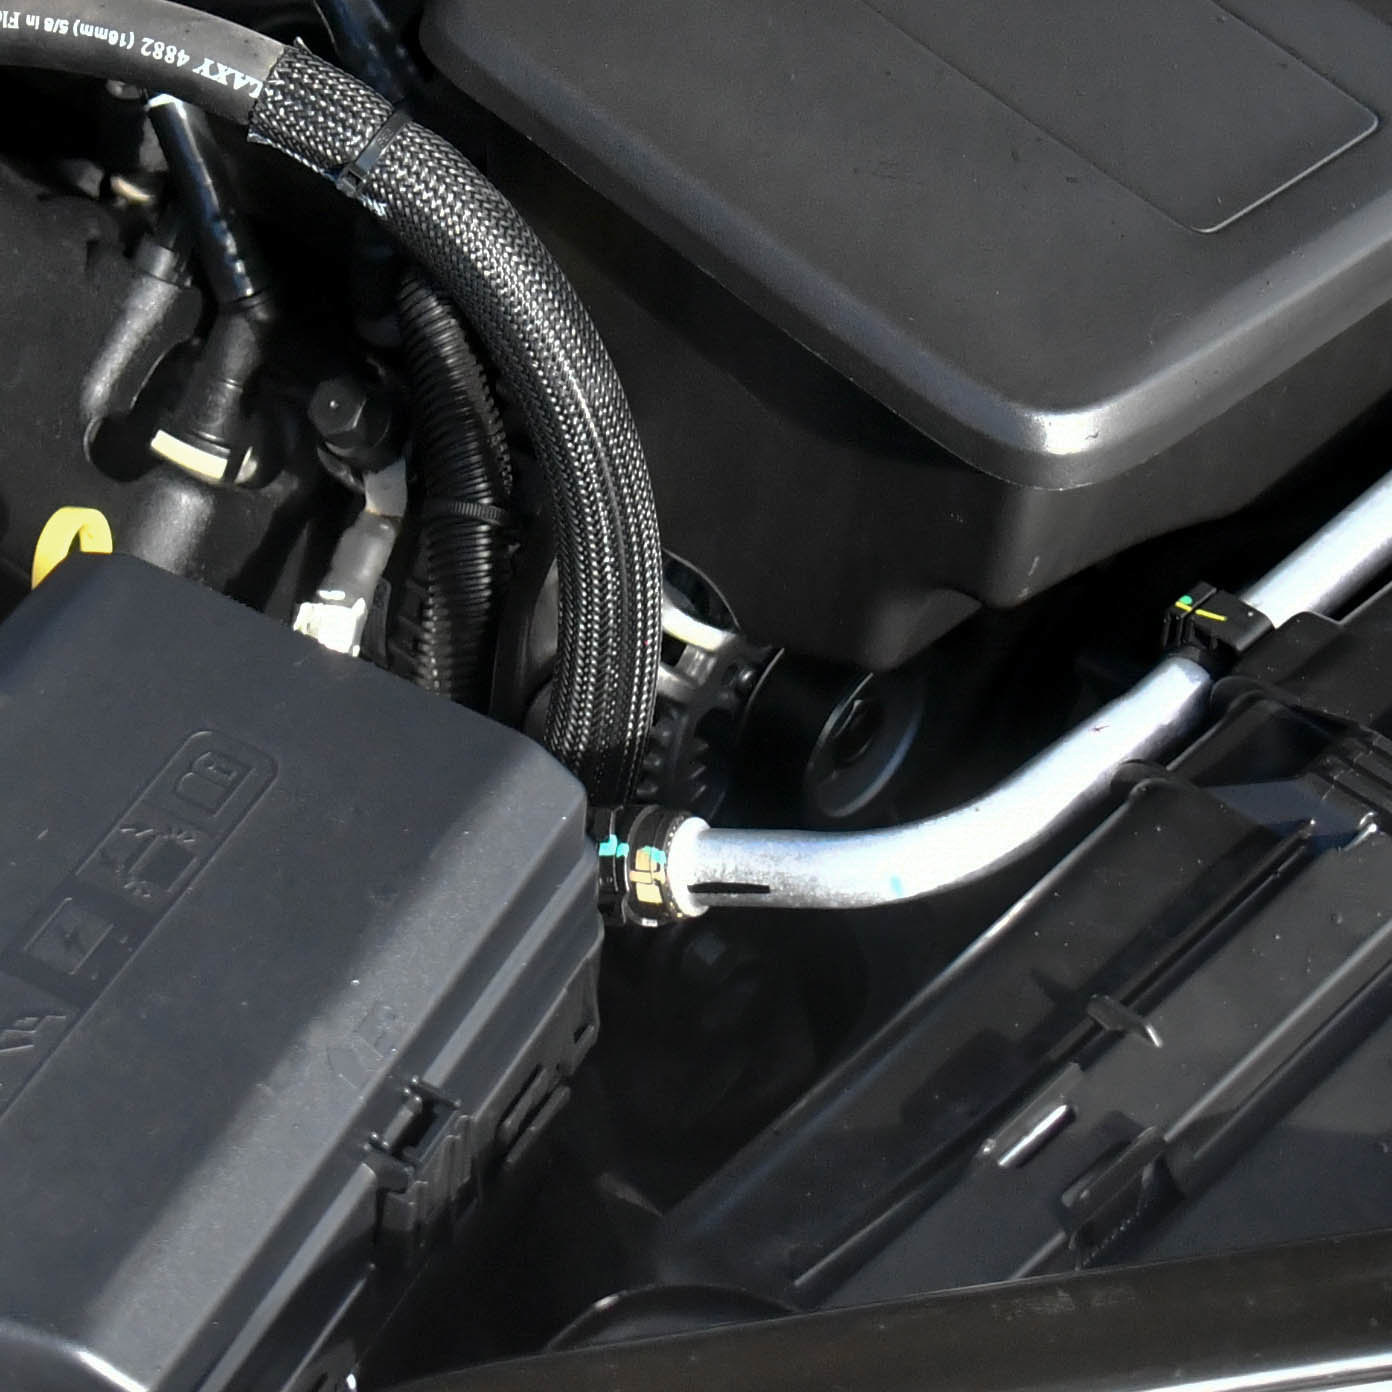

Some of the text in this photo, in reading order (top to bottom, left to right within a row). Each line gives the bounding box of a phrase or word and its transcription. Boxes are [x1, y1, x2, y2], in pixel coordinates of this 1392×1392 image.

[26, 15, 40, 30] in
[44, 18, 69, 35] 5/8
[73, 20, 134, 49] (16mm)
[141, 38, 190, 67] 4882
